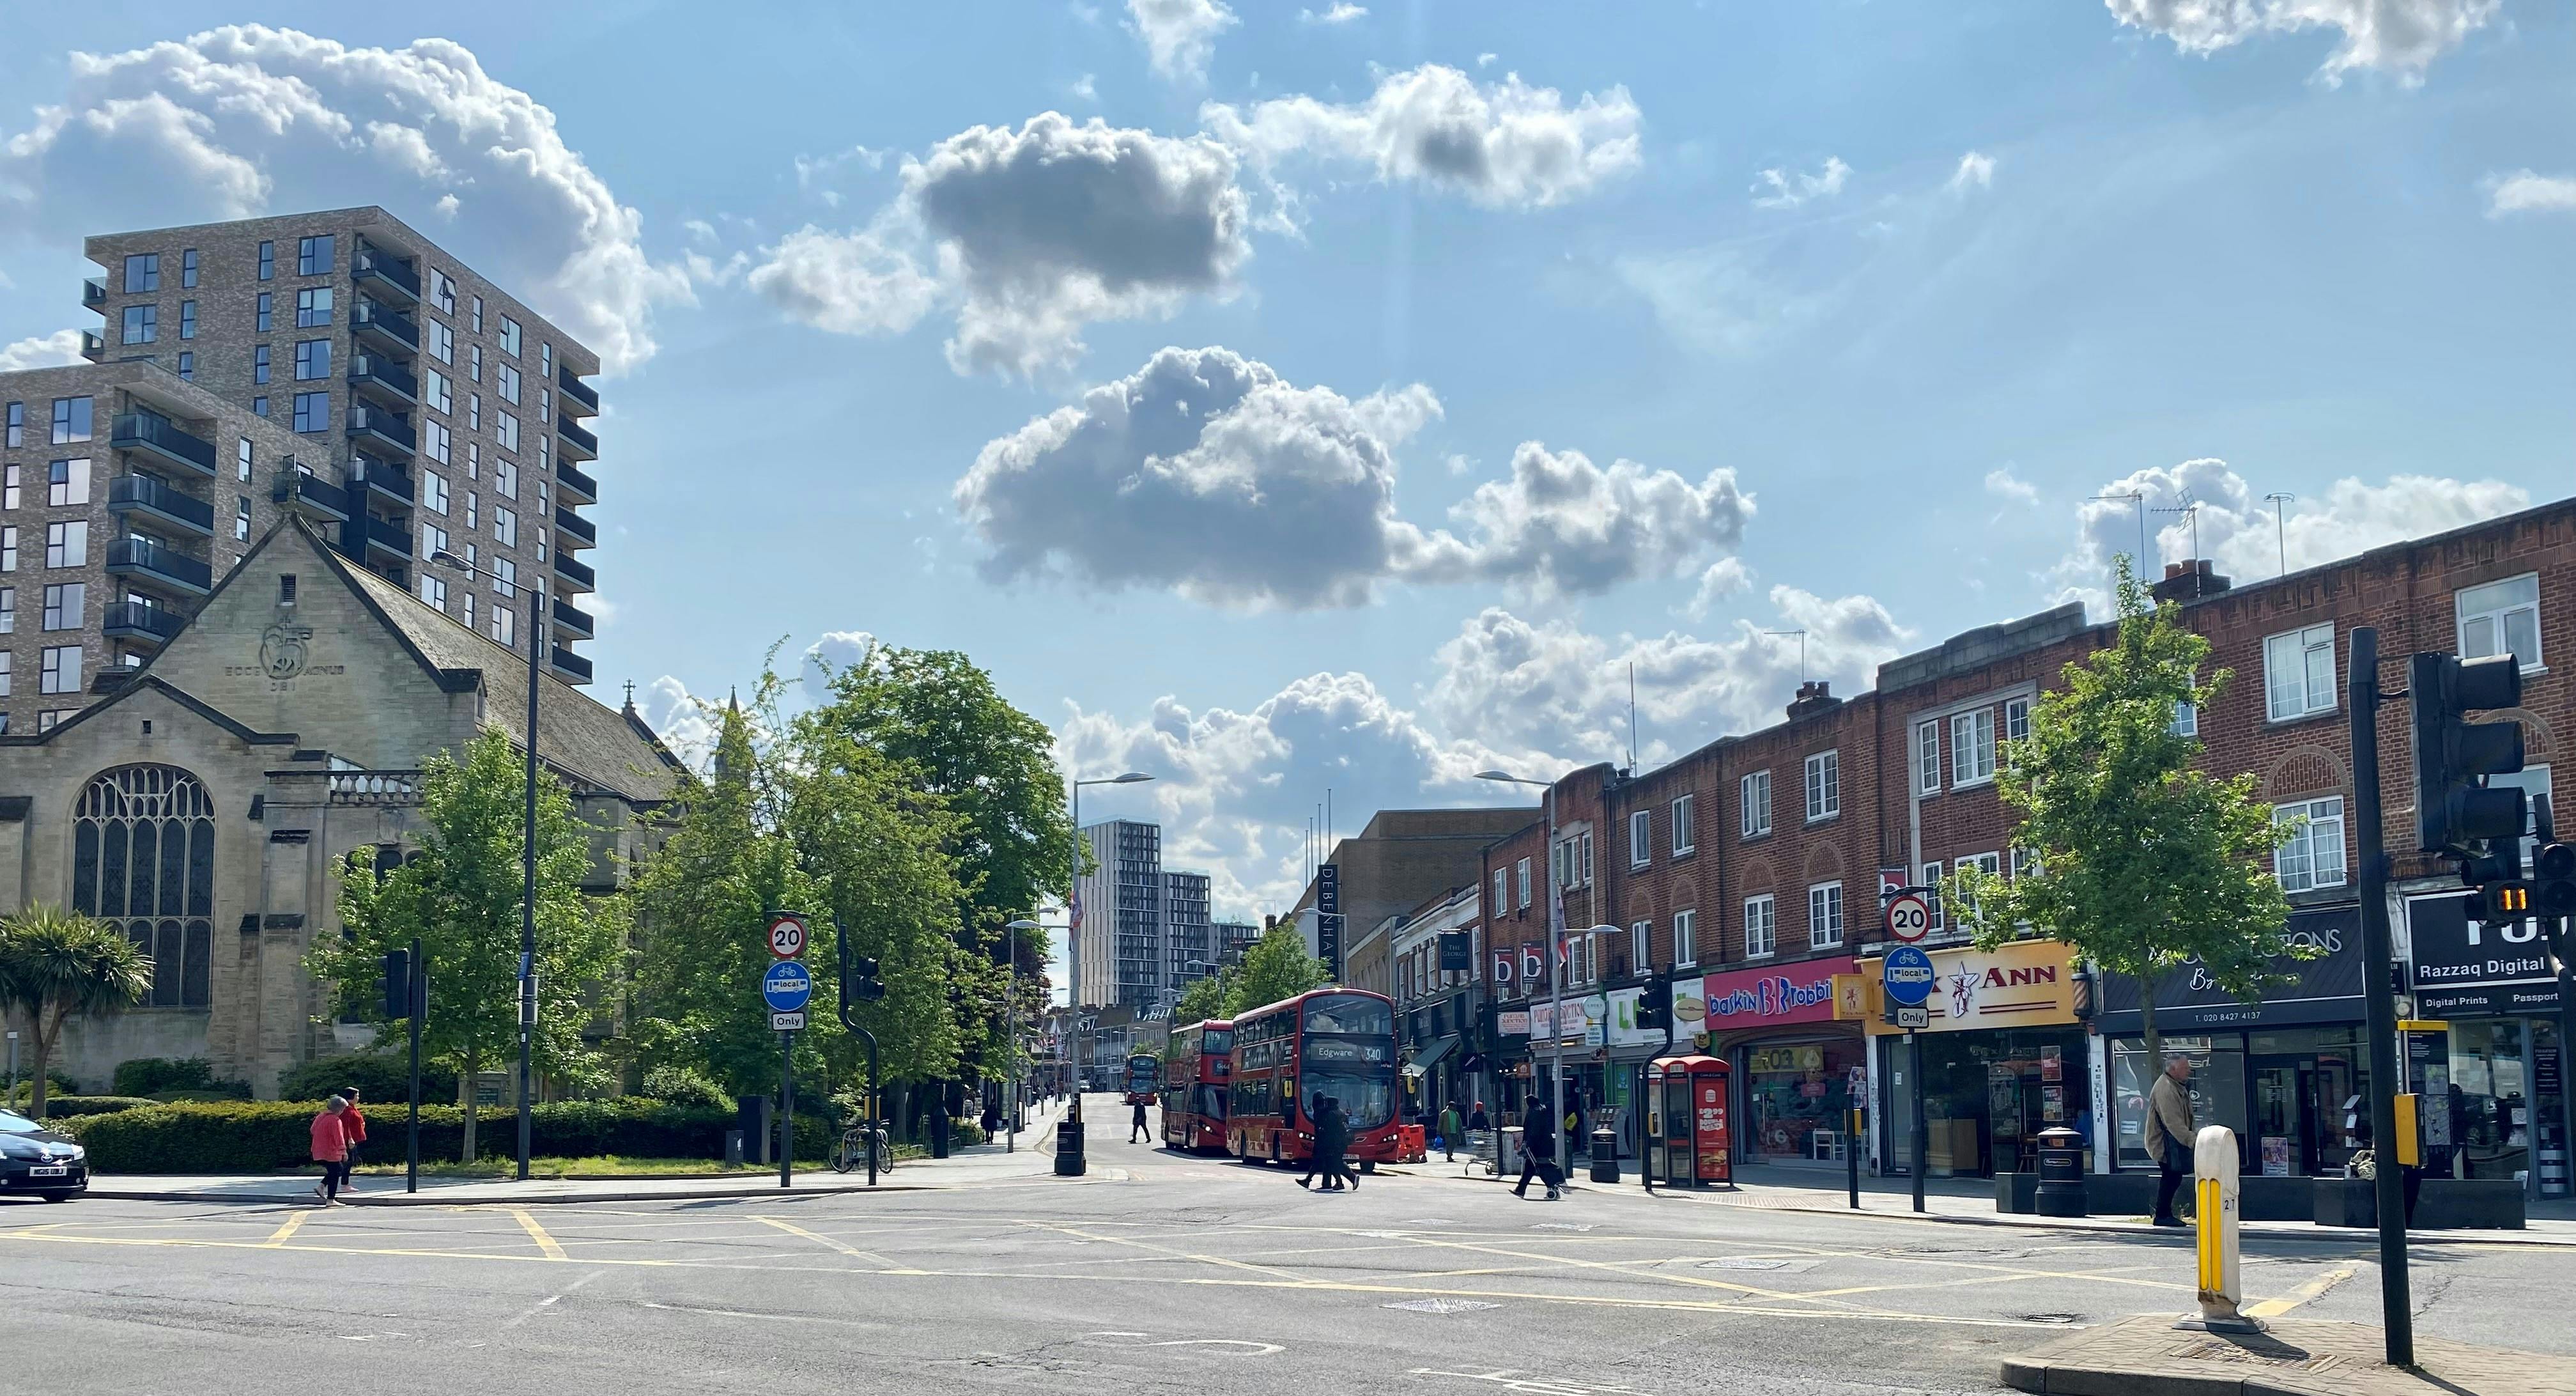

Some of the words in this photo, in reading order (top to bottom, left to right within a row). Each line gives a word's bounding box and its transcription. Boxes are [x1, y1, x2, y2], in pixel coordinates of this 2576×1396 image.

[225, 666, 261, 676] ECCE
[304, 665, 344, 676] AGNUS
[270, 681, 296, 692] DEI
[1322, 868, 1334, 977] DEBENHAM
[1894, 909, 1925, 928] 20
[775, 929, 800, 947] 20
[1495, 953, 1513, 982] b
[1523, 947, 1542, 977] b
[2419, 964, 2481, 979] Razzaq
[2487, 956, 2545, 975] Digital
[1901, 967, 1922, 977] local
[1979, 965, 2056, 989] ANN
[2189, 967, 2215, 990] By
[1708, 988, 1757, 1016] baskin
[1757, 976, 1792, 1016] BR
[1791, 978, 1833, 1007] robbi
[2426, 998, 2457, 1008] Digital
[2459, 996, 2488, 1005] Prints
[2513, 992, 2559, 1003] Passport
[776, 1017, 800, 1026] Only
[1901, 1011, 1925, 1023] Only
[2203, 1013, 2218, 1022] 020
[2219, 1012, 2239, 1021] 8427
[2242, 1011, 2261, 1020] 4137
[1318, 1048, 1353, 1058] Edgware
[1365, 1048, 1381, 1060] 340
[2225, 1198, 2235, 1210] 27
